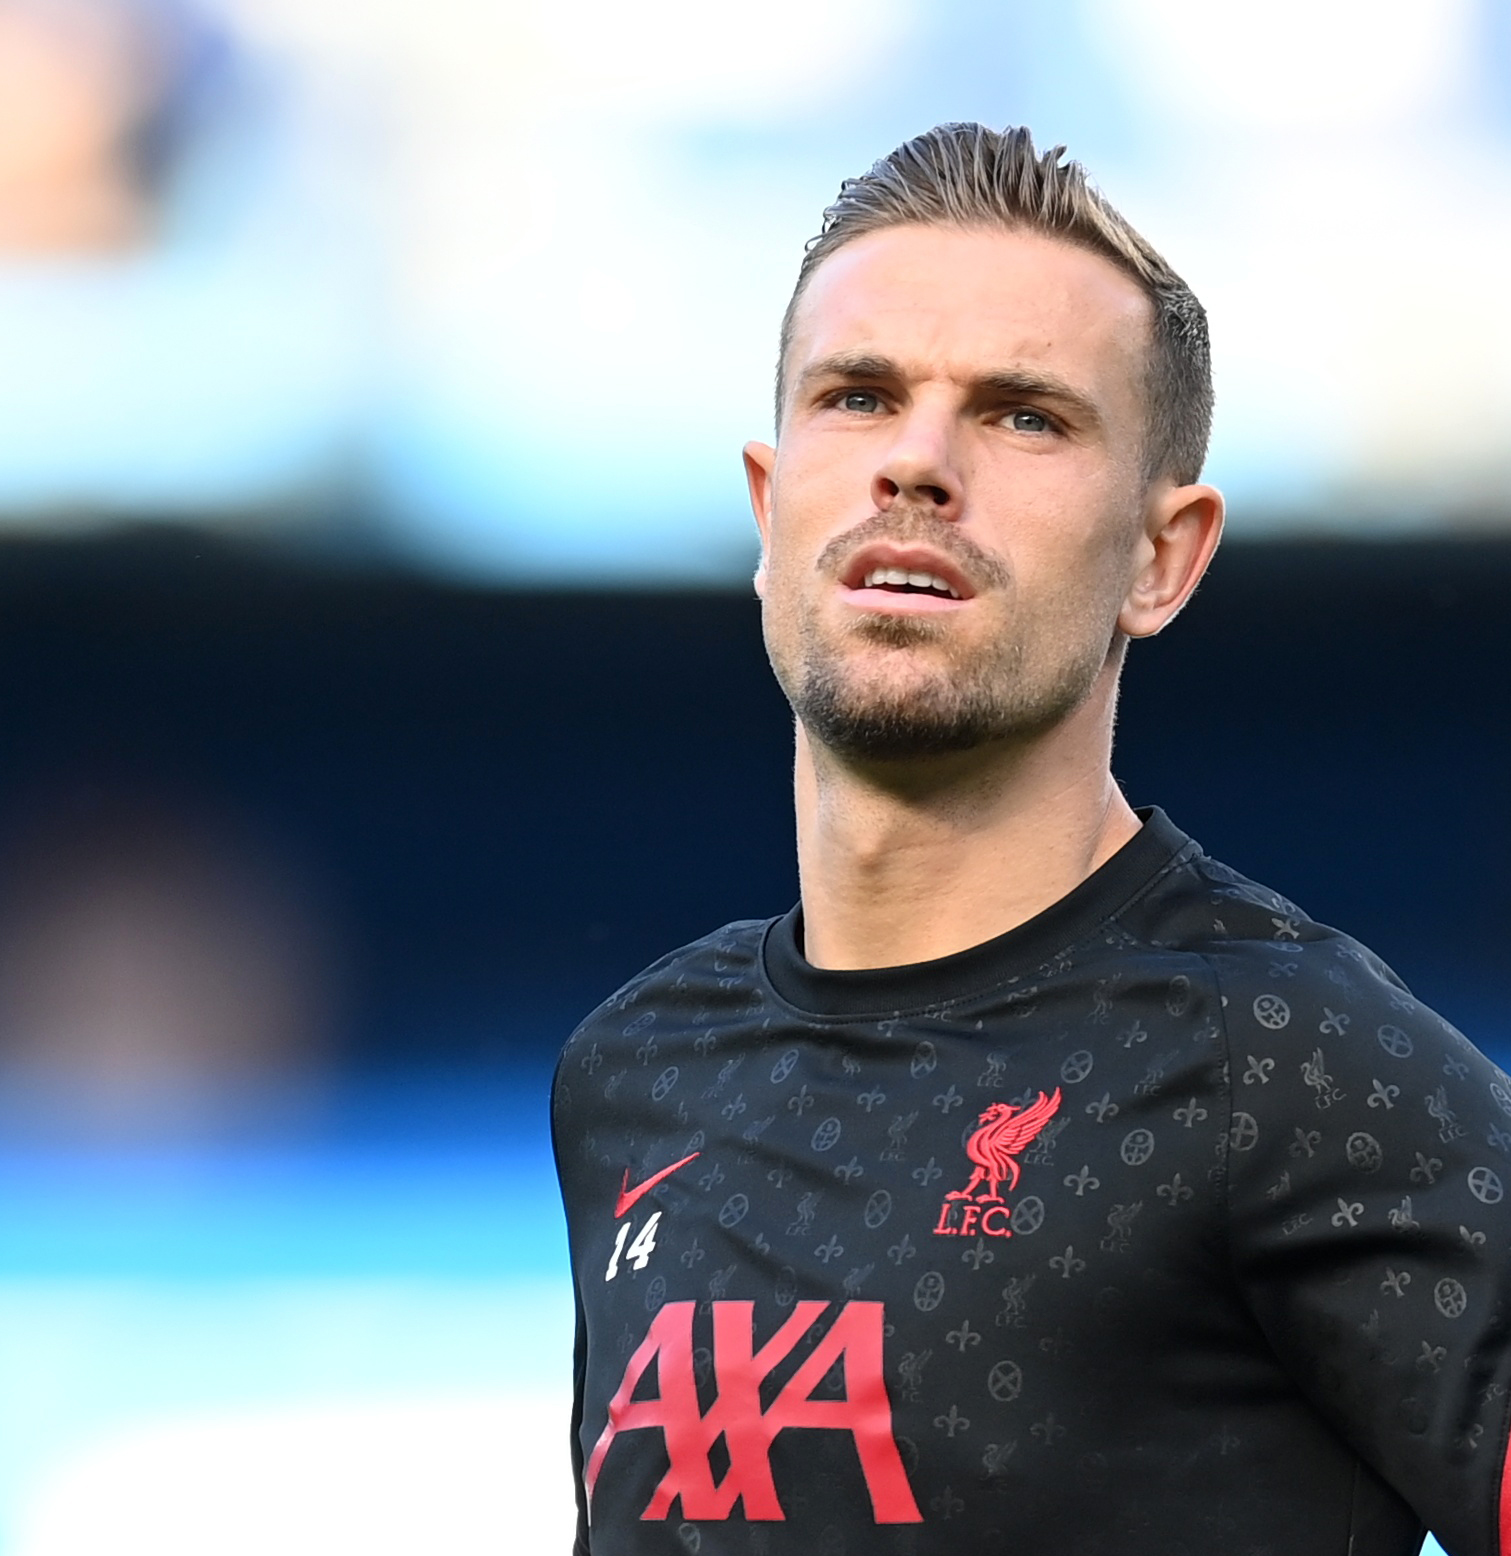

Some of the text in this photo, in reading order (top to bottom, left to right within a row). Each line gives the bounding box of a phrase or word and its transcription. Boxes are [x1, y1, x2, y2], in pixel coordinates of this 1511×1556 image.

[605, 1211, 662, 1282] 14
[933, 1203, 1012, 1237] L.F.C.
[585, 1300, 924, 1523] AXA
